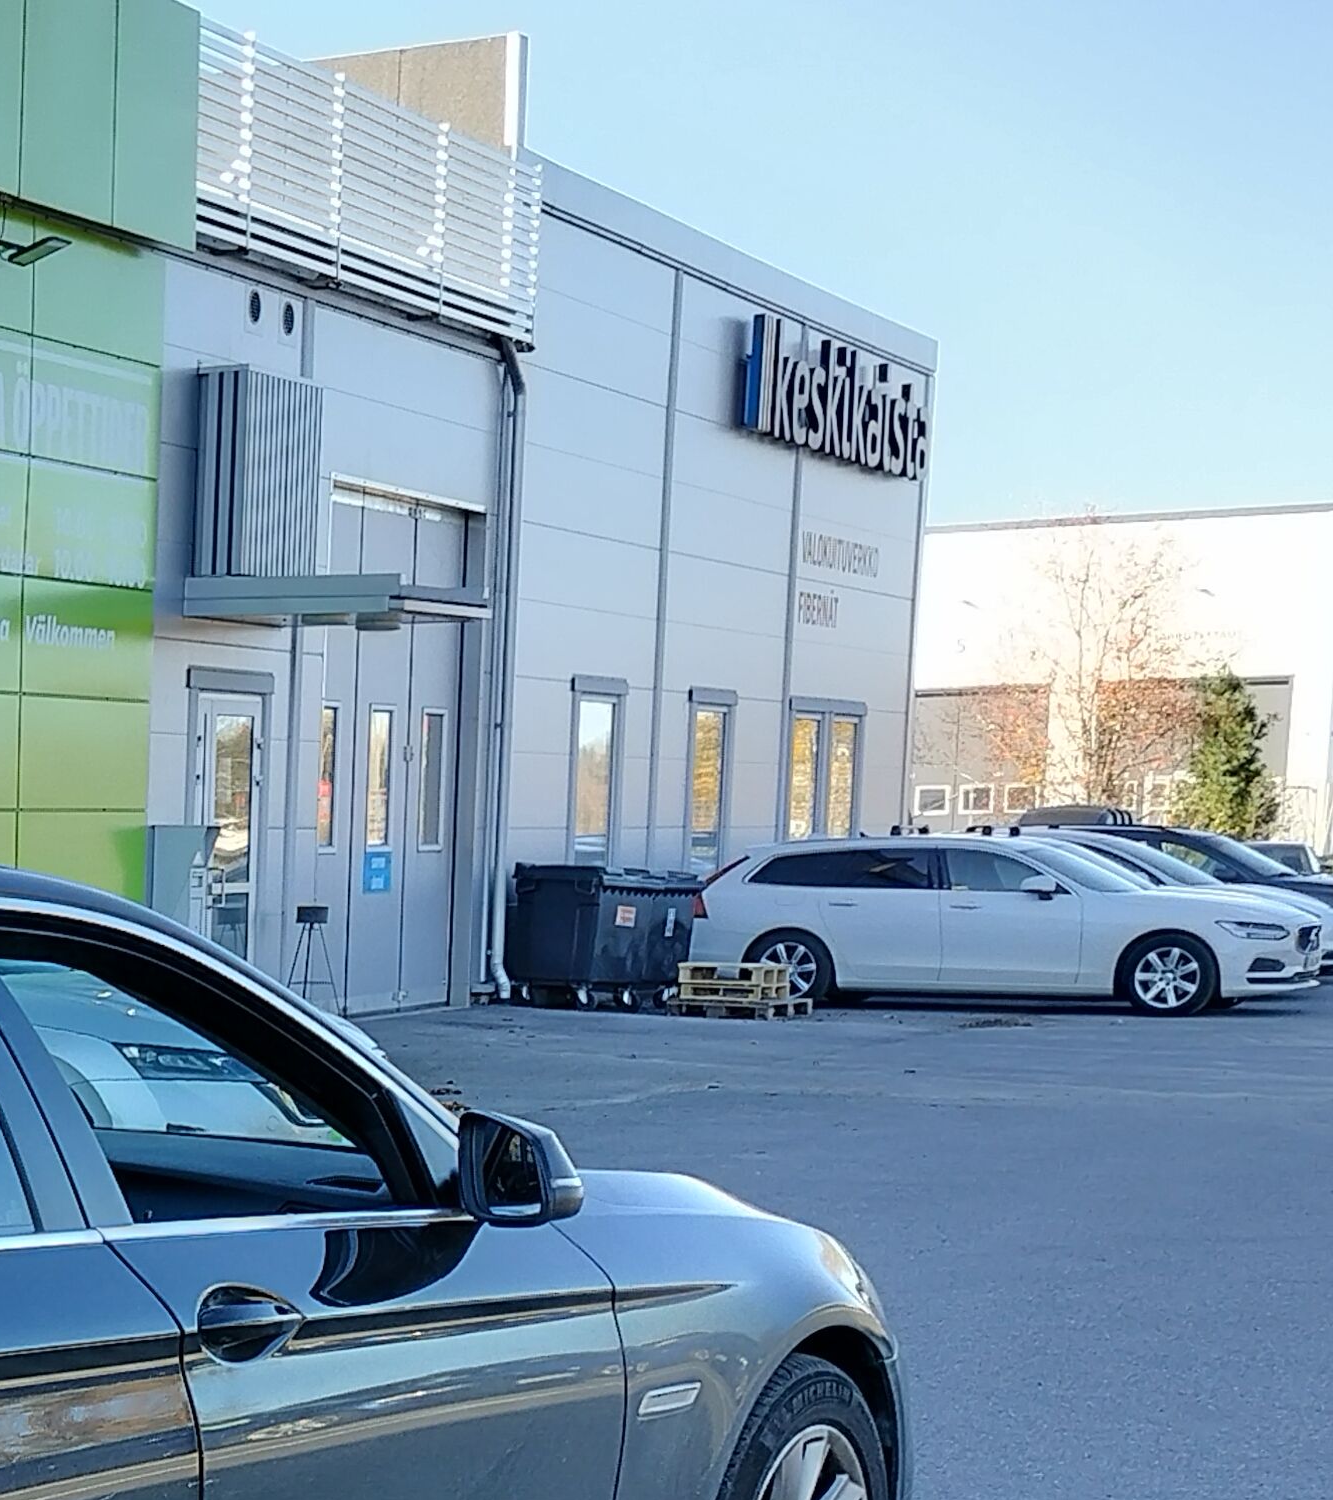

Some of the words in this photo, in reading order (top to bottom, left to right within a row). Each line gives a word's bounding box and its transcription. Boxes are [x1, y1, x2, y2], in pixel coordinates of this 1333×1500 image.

[773, 317, 930, 481] keskikaista
[801, 530, 880, 578] VALOKUITUVERKKO
[25, 613, 116, 652] Välkommen
[791, 1381, 852, 1415] MICHELIN
